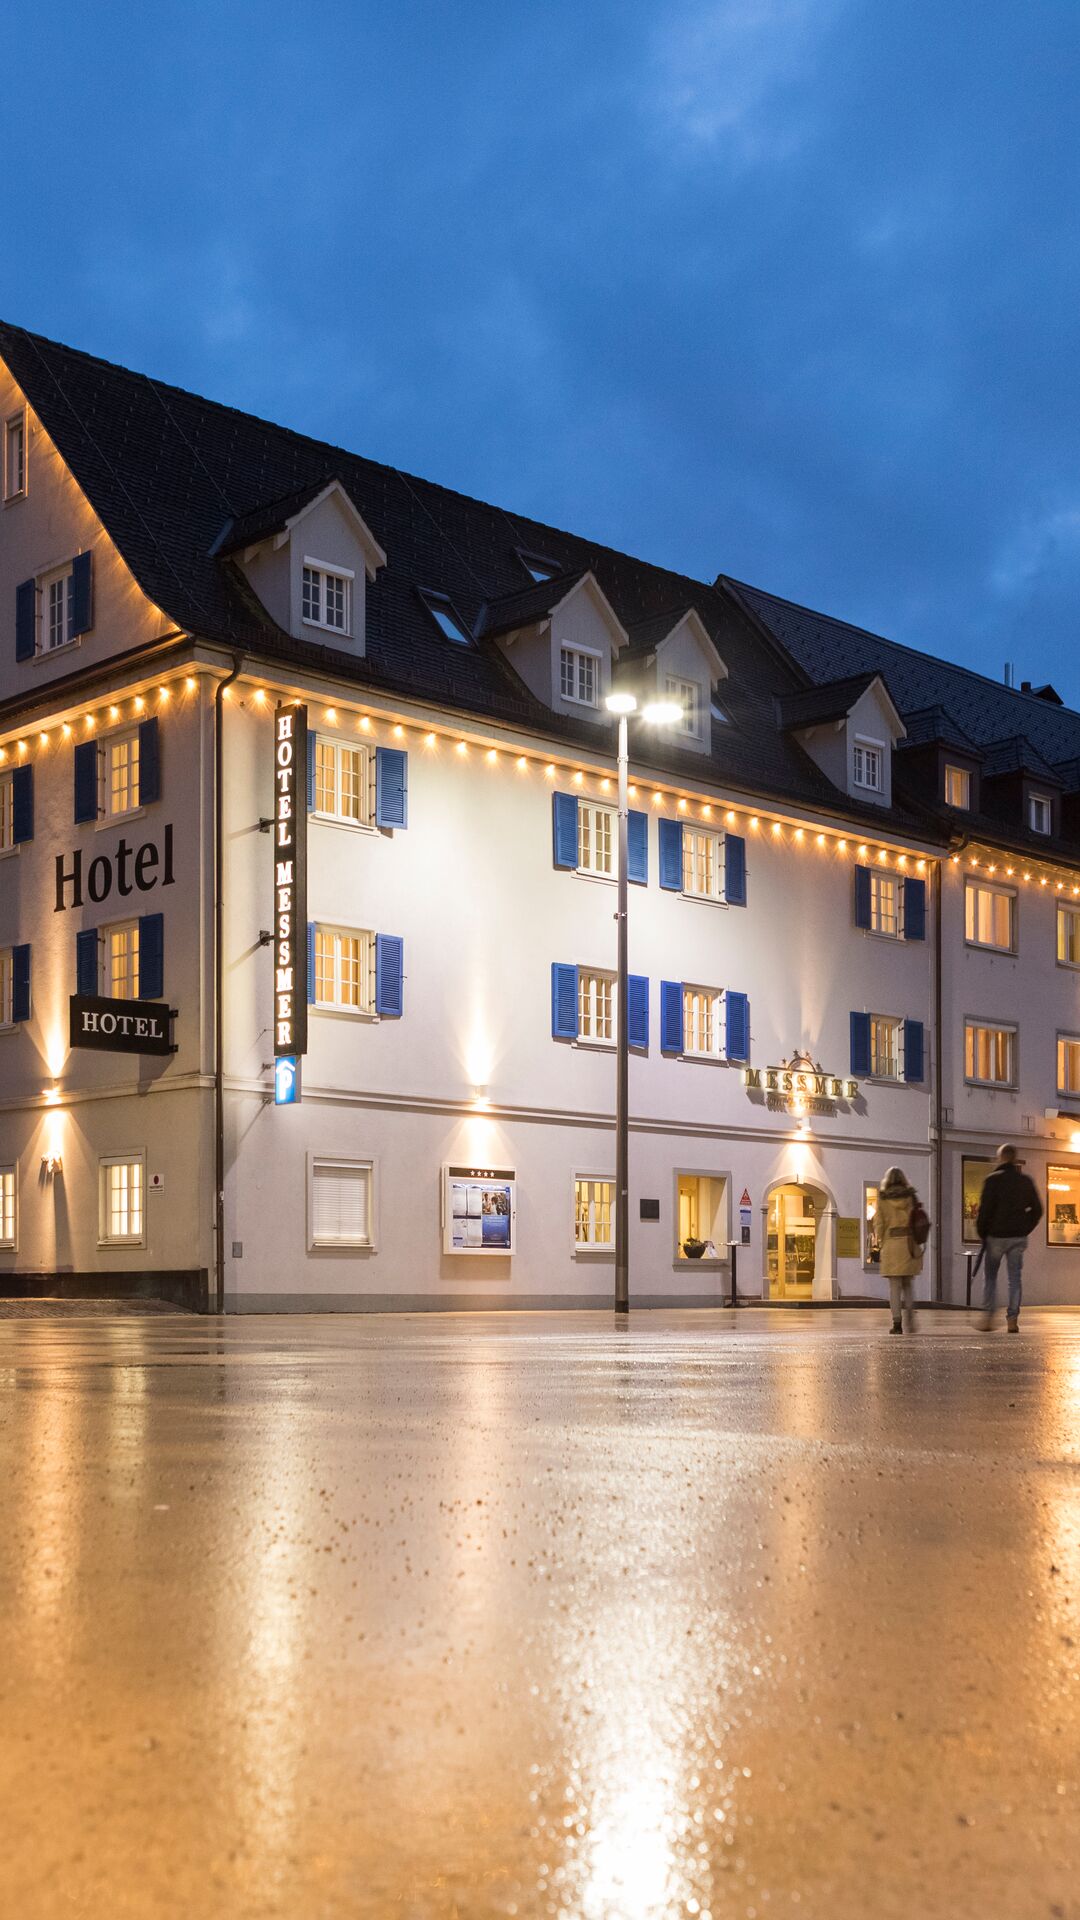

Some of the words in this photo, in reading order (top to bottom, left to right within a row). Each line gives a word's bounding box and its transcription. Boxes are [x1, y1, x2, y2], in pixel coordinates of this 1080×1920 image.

[277, 715, 293, 847] HOTEL
[54, 823, 175, 912] Hotel
[276, 861, 293, 1046] MESSMER
[81, 1011, 163, 1038] HOTEL
[278, 1069, 293, 1100] P
[745, 1068, 859, 1098] MESSMER
